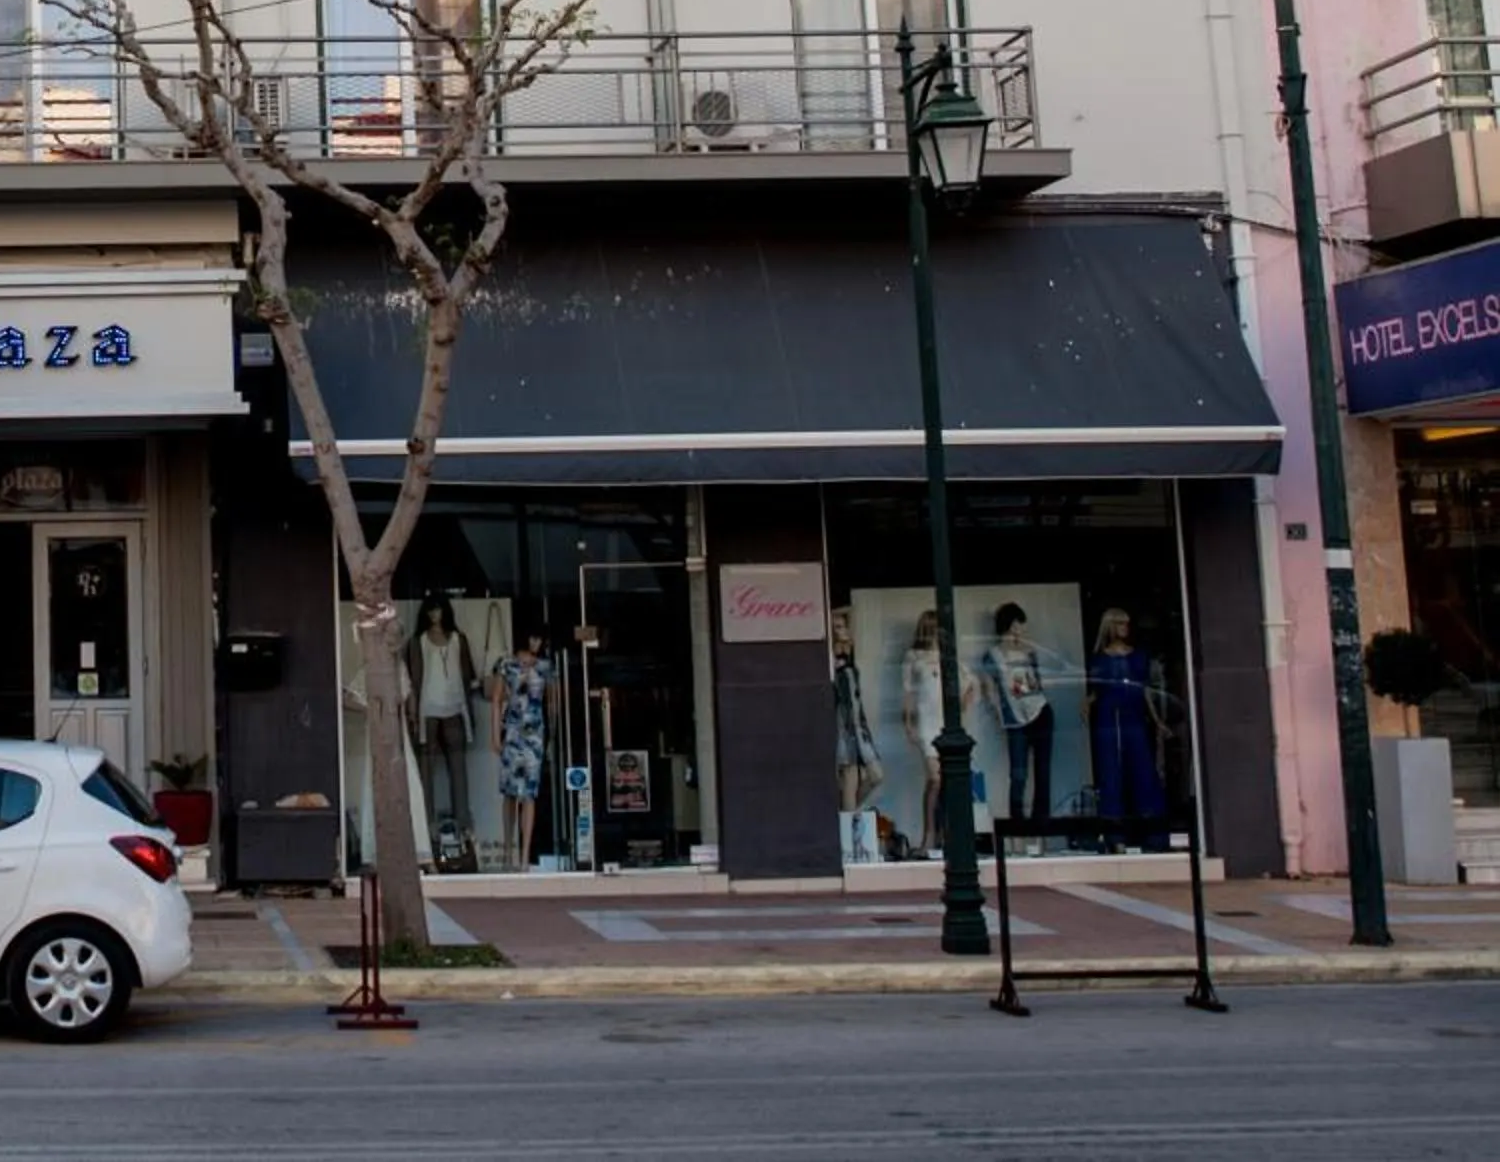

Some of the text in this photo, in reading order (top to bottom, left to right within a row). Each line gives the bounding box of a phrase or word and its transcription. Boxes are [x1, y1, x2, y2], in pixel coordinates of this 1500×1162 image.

[1349, 317, 1414, 366] HOTEL
[0, 467, 63, 496] plaza
[728, 583, 815, 619] Grace
